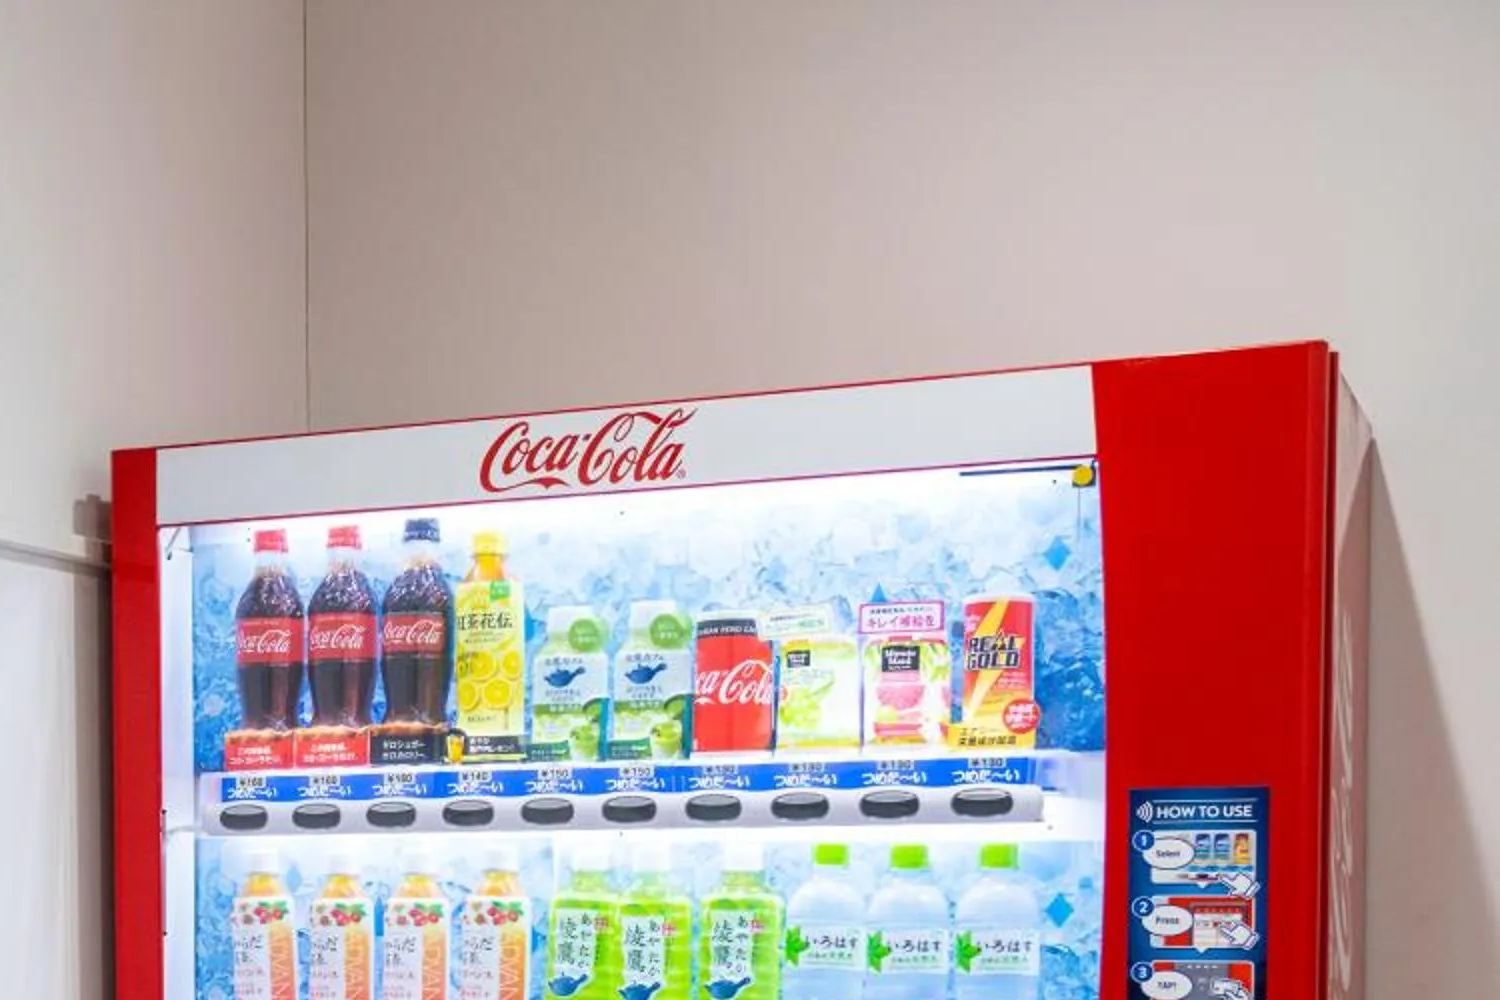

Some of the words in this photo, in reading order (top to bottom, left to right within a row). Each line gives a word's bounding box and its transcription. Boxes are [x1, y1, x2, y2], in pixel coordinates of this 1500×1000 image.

[479, 408, 698, 492] Coca-Cola
[383, 619, 443, 646] Coca-Cola
[970, 633, 1016, 653] REAL
[967, 651, 1020, 671] GOLD
[695, 658, 773, 705] ca-Cola
[1156, 806, 1195, 818] HOW
[1198, 805, 1220, 818] TO
[1223, 805, 1252, 817] USE
[1156, 849, 1180, 858] Select
[1139, 902, 1148, 913] 2
[888, 938, 941, 953] いろはす
